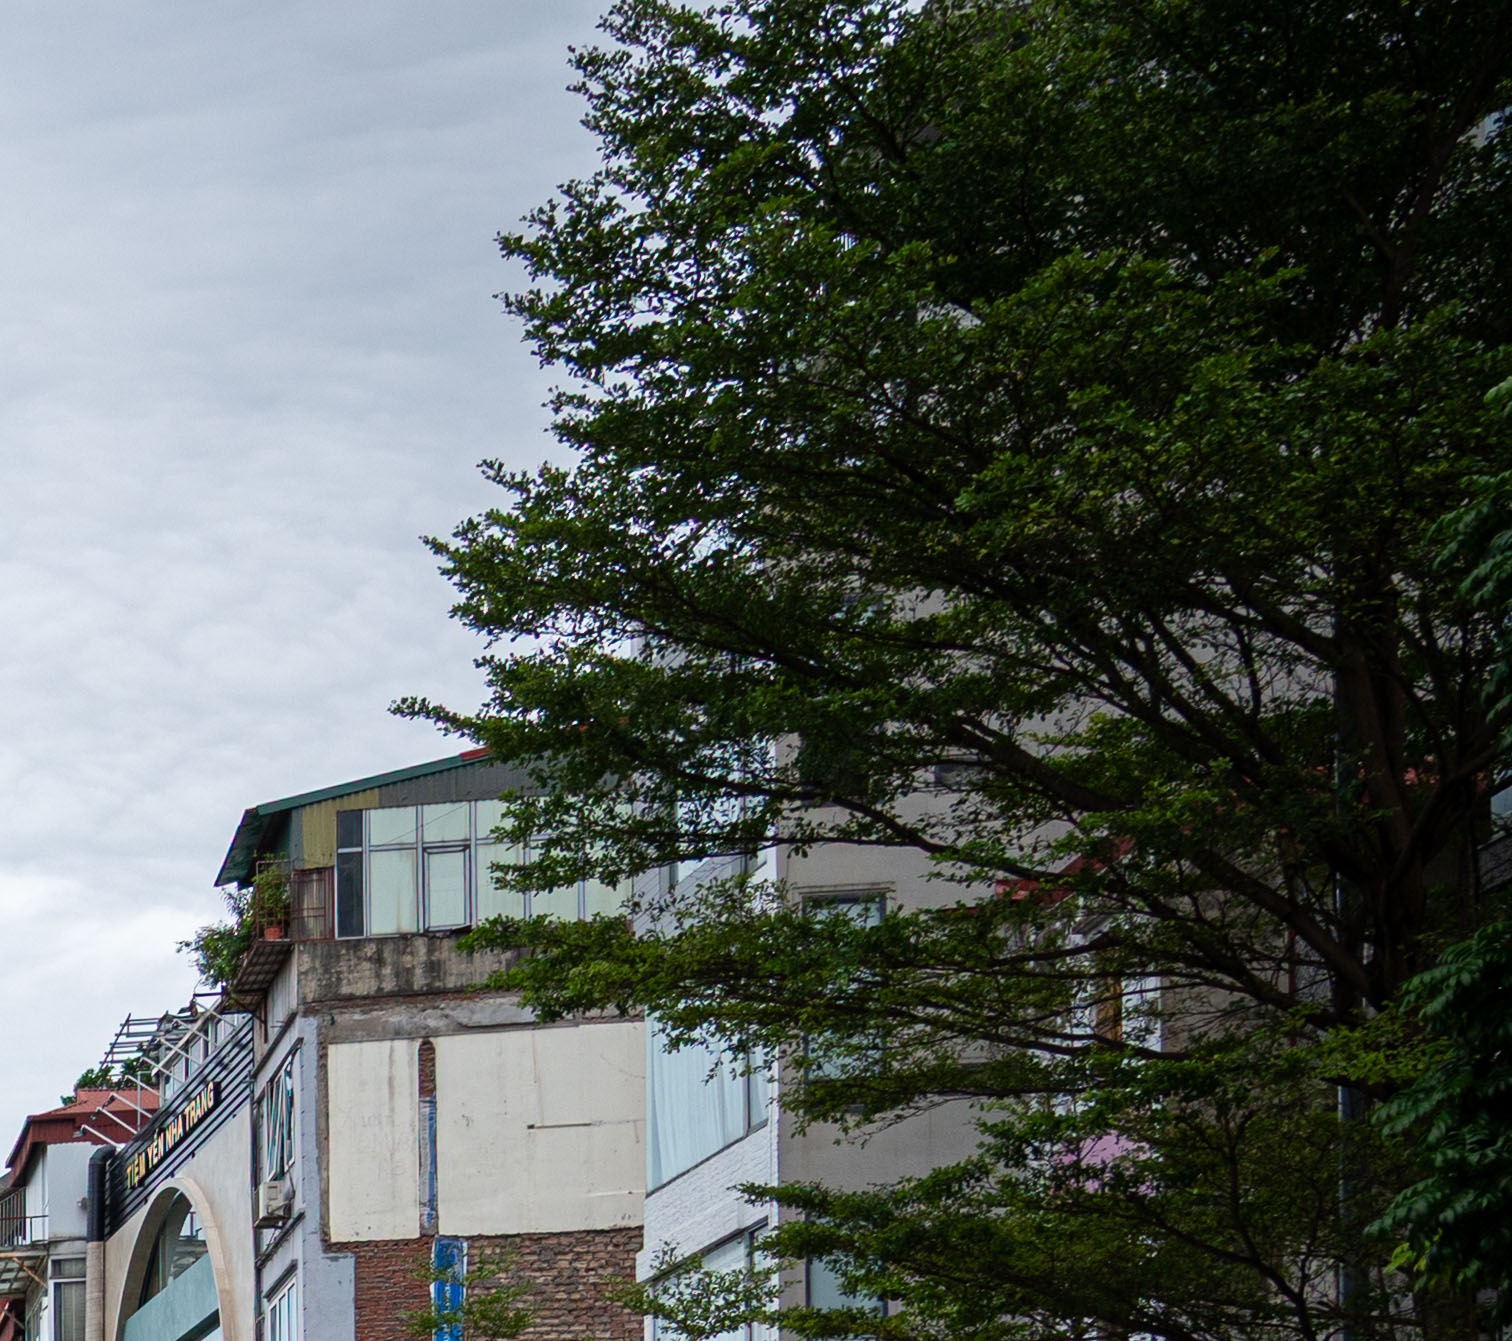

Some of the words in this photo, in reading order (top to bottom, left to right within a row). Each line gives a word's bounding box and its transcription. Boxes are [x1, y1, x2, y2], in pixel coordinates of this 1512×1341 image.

[147, 1128, 164, 1168] YẾN
[165, 1114, 184, 1152] NHA
[184, 1081, 214, 1131] TRANG
